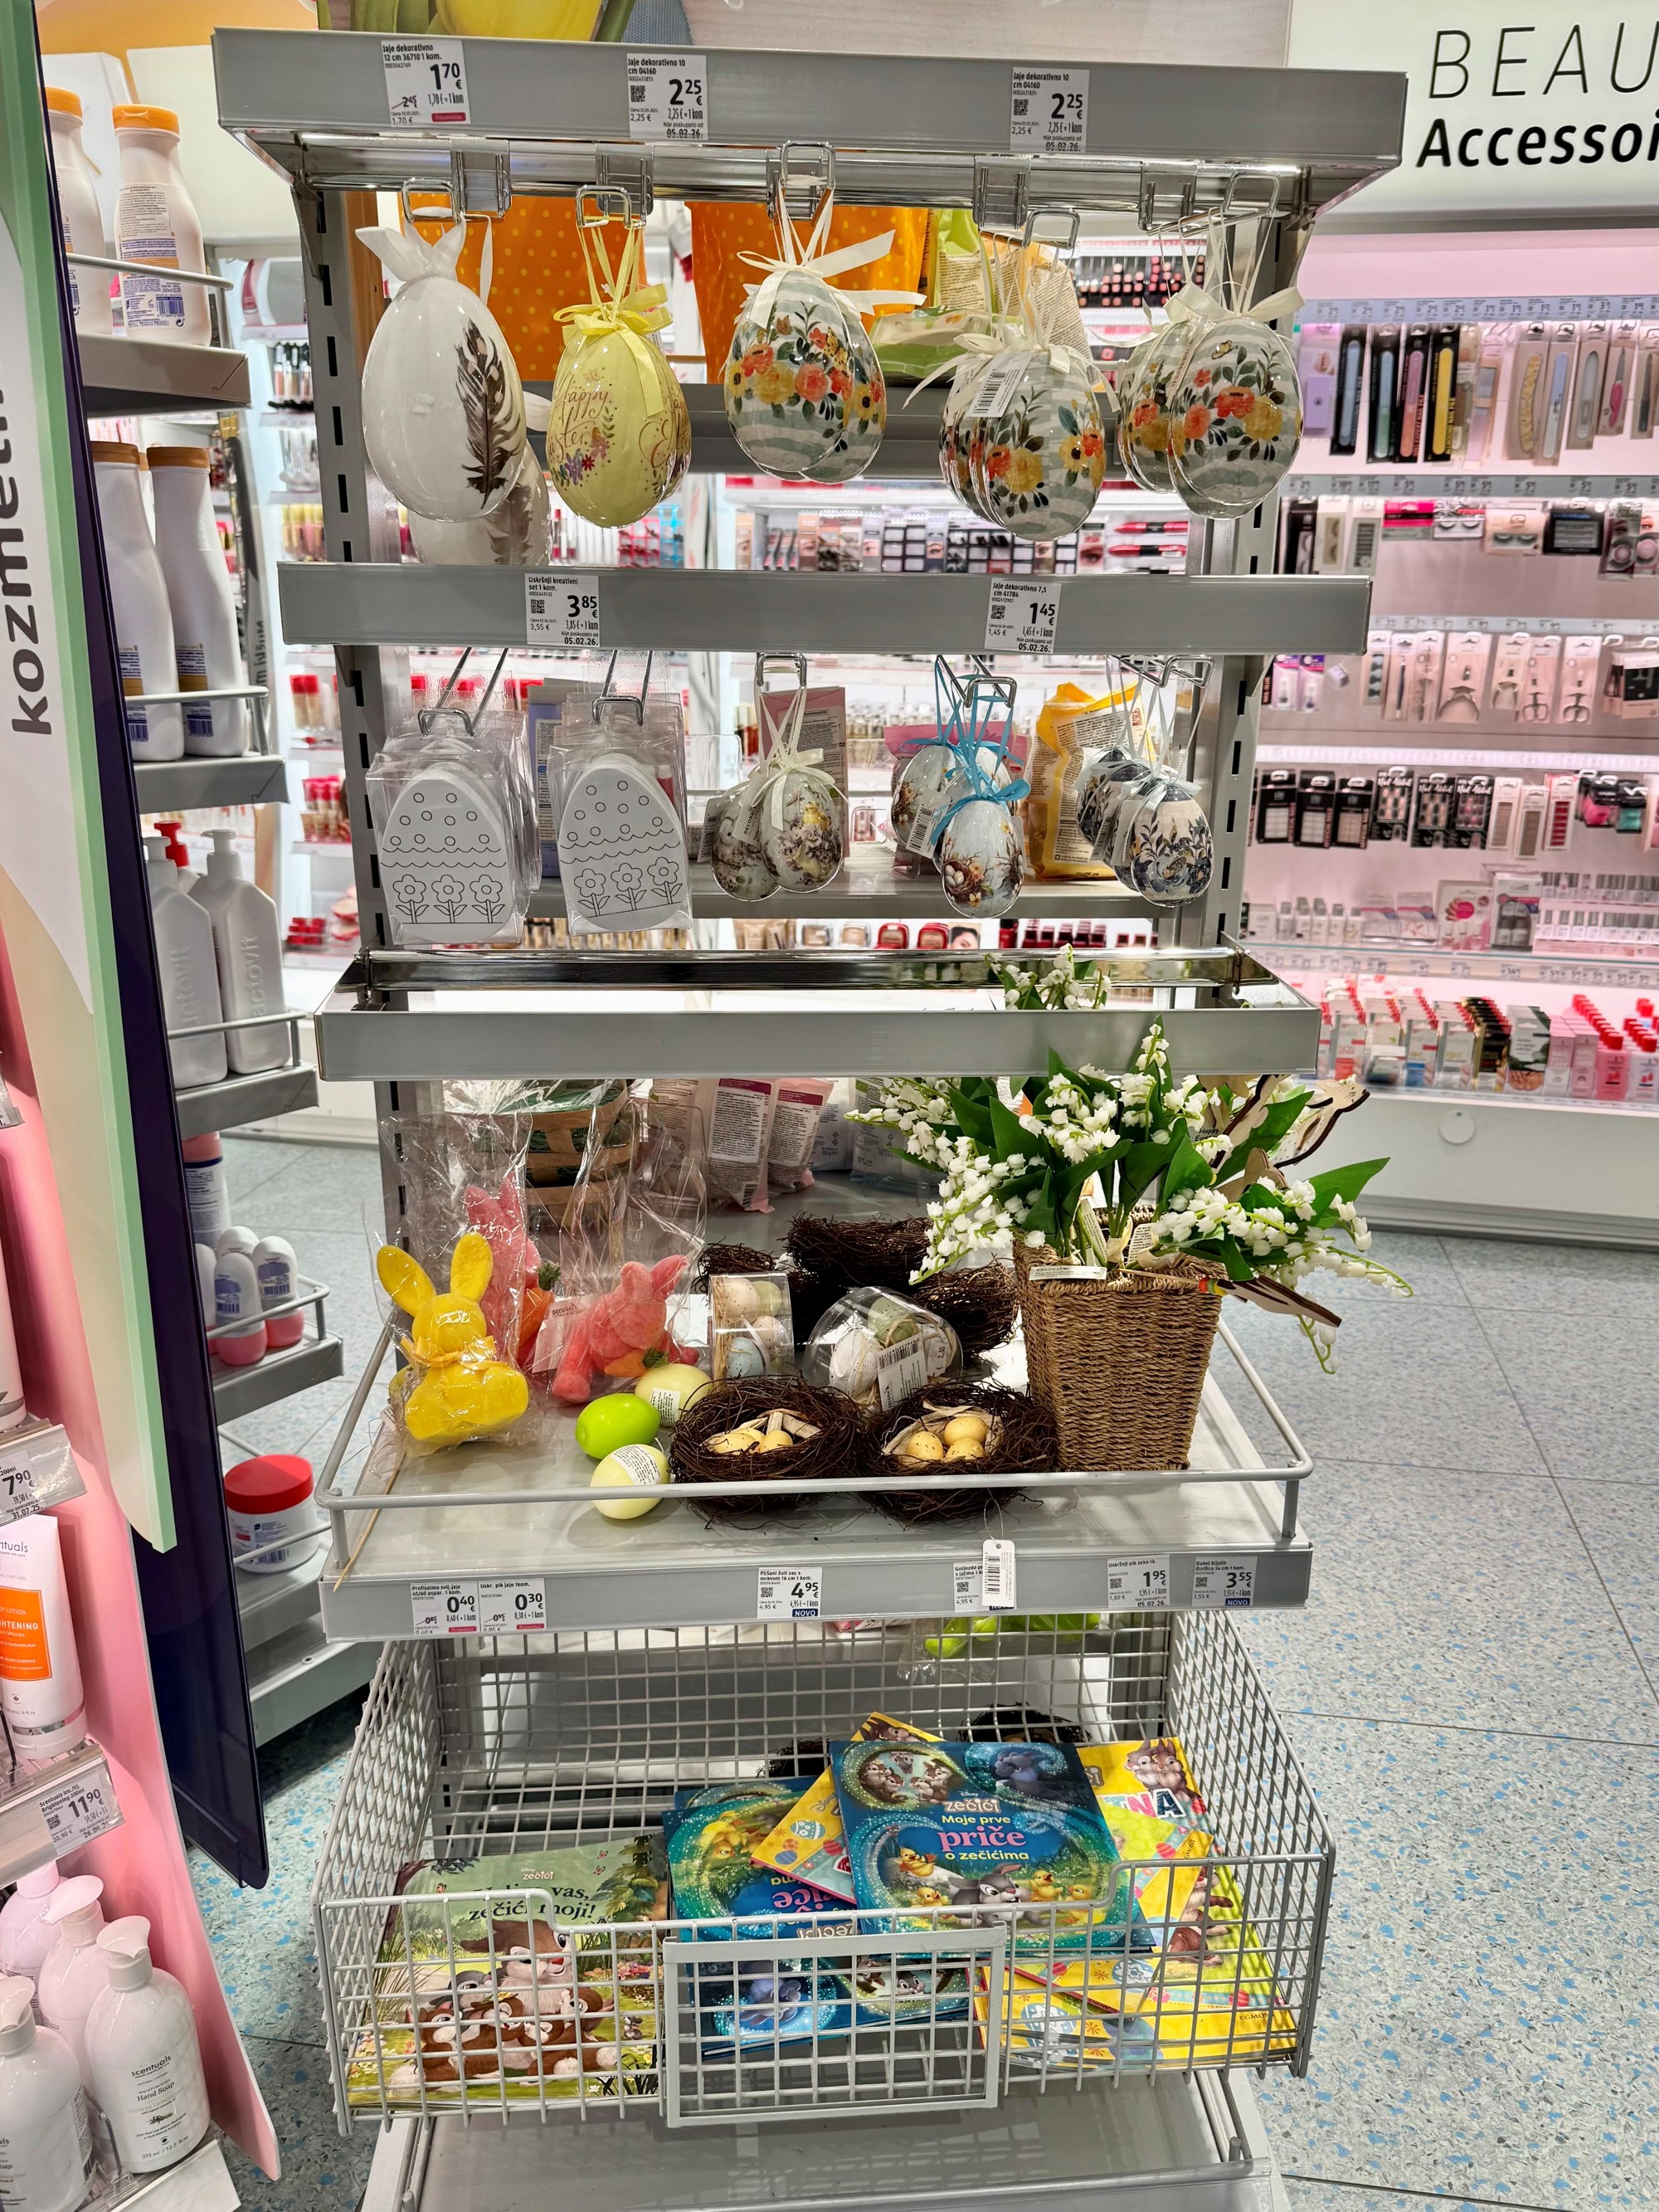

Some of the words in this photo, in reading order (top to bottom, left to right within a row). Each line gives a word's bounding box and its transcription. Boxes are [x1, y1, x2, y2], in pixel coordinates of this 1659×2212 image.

[382, 44, 395, 53] Jaje
[396, 44, 433, 52] dekorativno
[628, 58, 640, 66] Jaje
[641, 58, 678, 66] dekorativno
[1014, 72, 1024, 80] Jaje
[1026, 72, 1061, 80] dekorativno
[630, 114, 645, 122] 2,25
[1005, 583, 1037, 592] dekorativno
[564, 637, 598, 646] 05.02.26.
[1019, 643, 1050, 652] 05.02.26.
[12, 1503, 43, 1519] 31.07.25.
[39, 1792, 63, 1807] Scentuals
[41, 1795, 71, 1813] Brightening
[71, 1787, 85, 1798] 200ml
[942, 1798, 1000, 1812] zečići
[941, 1815, 975, 1825] Moje
[980, 1816, 1010, 1825] prve
[937, 1825, 1026, 1852] priče
[1185, 1839, 1195, 1859] GMONT
[959, 1850, 1029, 1859] zečićima
[523, 1871, 554, 1880] zečići
[551, 1887, 590, 1901] vas,
[132, 2055, 171, 2077] scentuals
[137, 2090, 157, 2102] Hand
[158, 2081, 175, 2095] Soap
